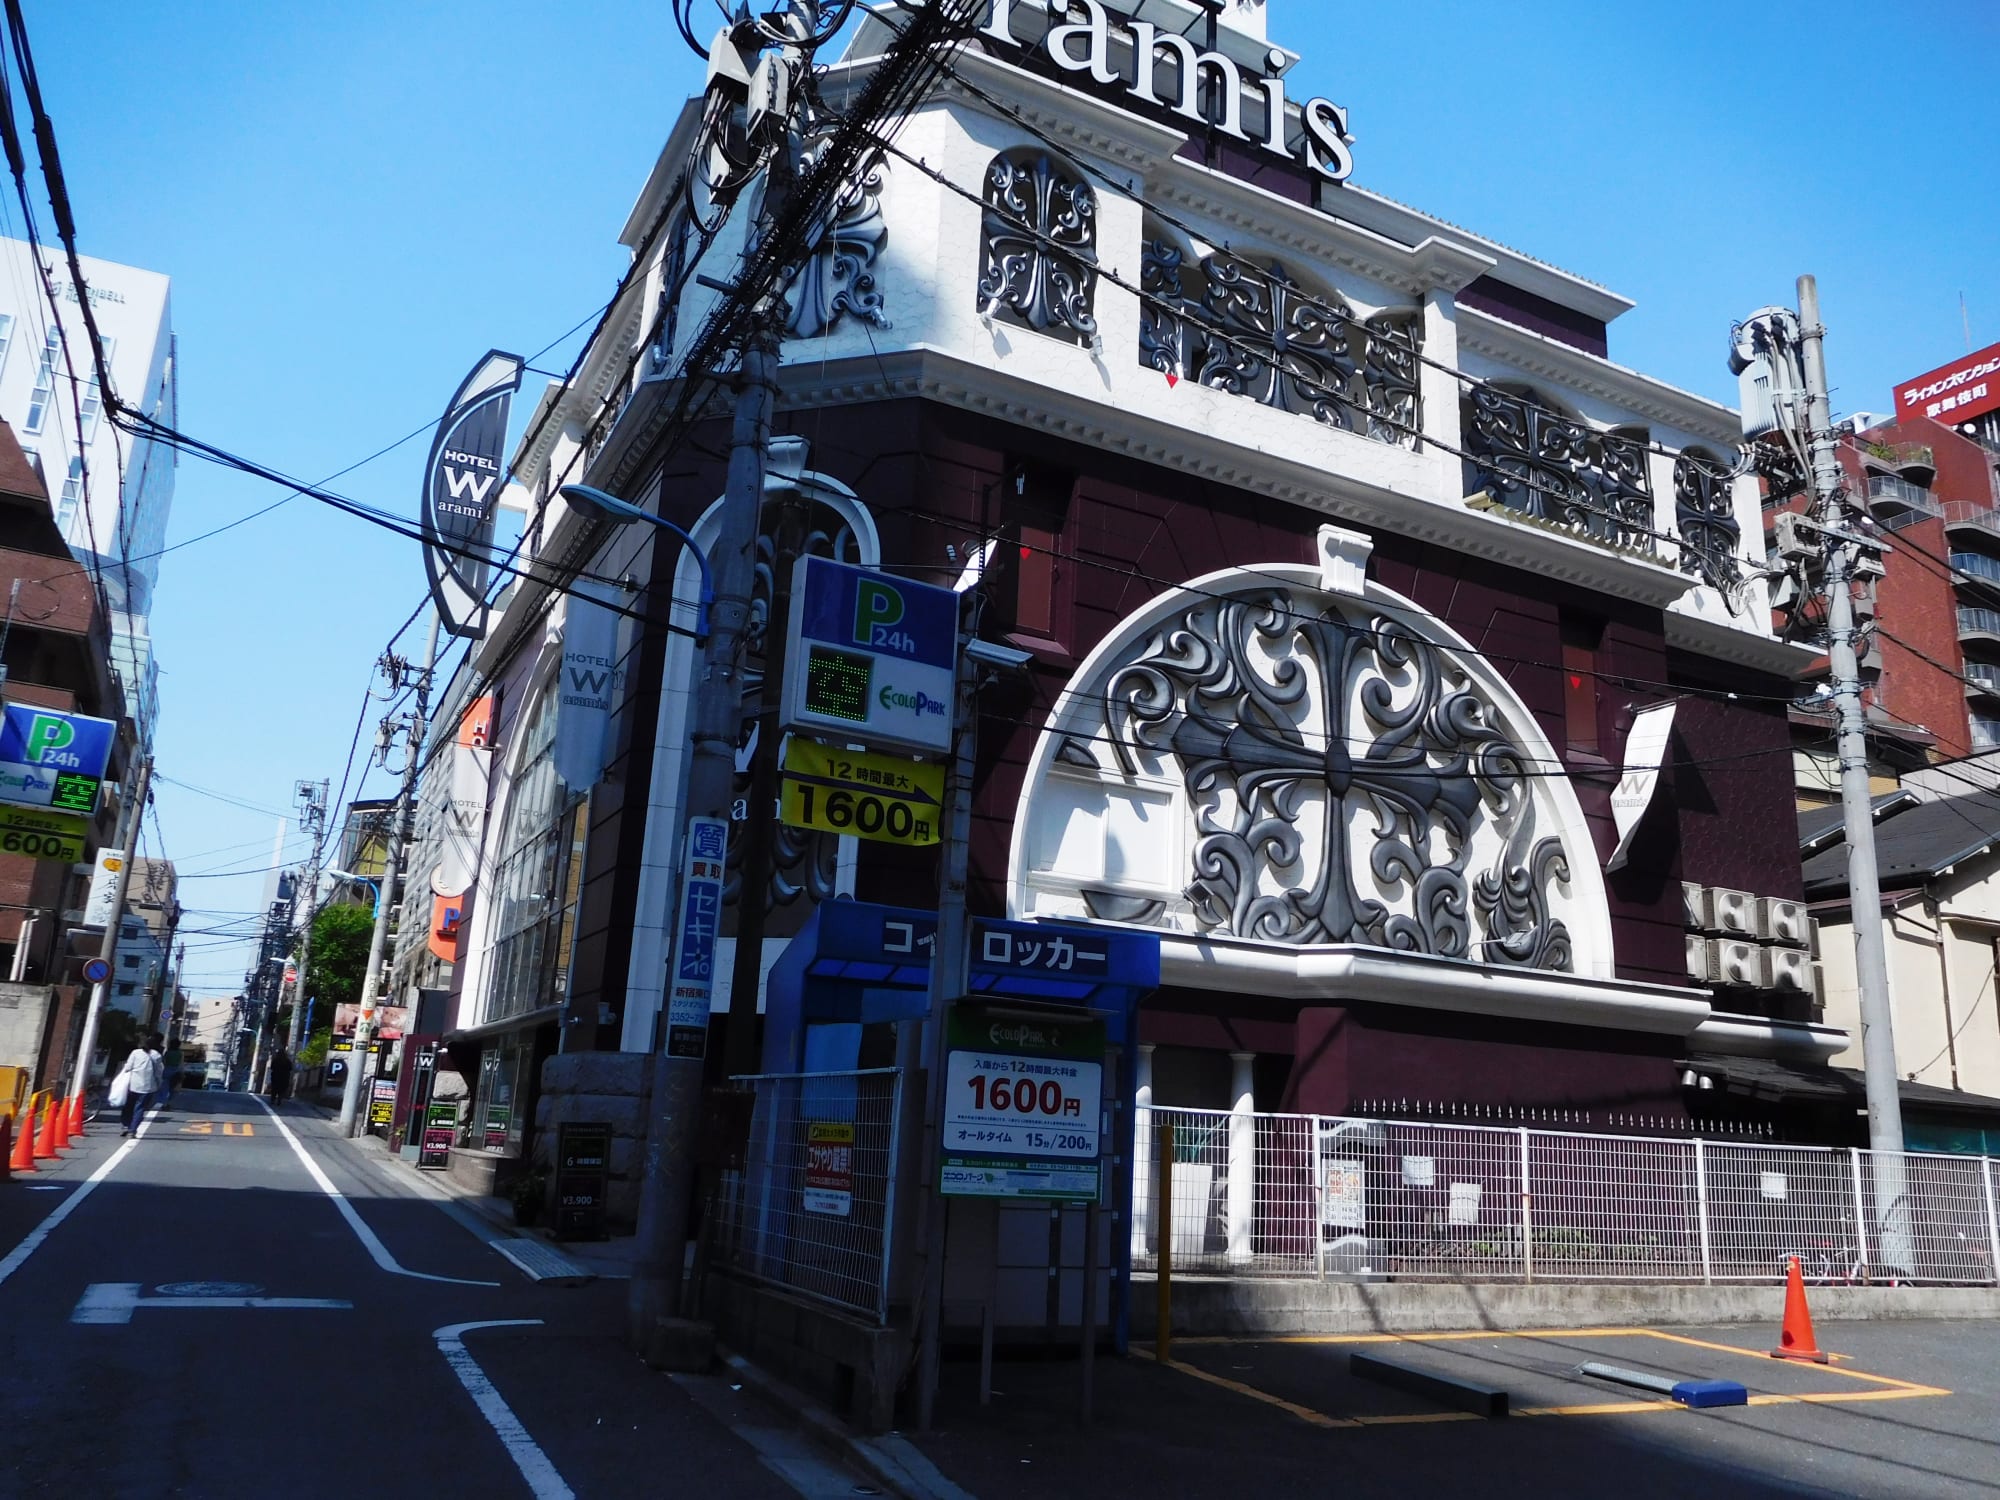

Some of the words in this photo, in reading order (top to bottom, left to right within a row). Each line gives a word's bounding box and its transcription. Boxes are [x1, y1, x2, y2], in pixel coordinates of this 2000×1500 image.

[1927, 384, 1987, 417] 歌舞伎町
[444, 449, 499, 472] HOTEL
[443, 466, 497, 503] W
[852, 576, 905, 646] P
[875, 628, 915, 654] 24h
[565, 652, 613, 669] HOTEL
[568, 667, 612, 695] W
[562, 695, 610, 711] aramis
[24, 713, 75, 764] P
[44, 749, 81, 769] 24h
[450, 799, 484, 810] HOTEL
[797, 784, 931, 842] 1600円
[453, 809, 480, 829] W
[691, 861, 722, 878] 買取
[683, 885, 716, 976] セキネ
[883, 920, 1107, 971] コイロッカー
[332, 1062, 343, 1075] P
[968, 1075, 1081, 1117] 1600円
[958, 1129, 1012, 1144] オールタイム
